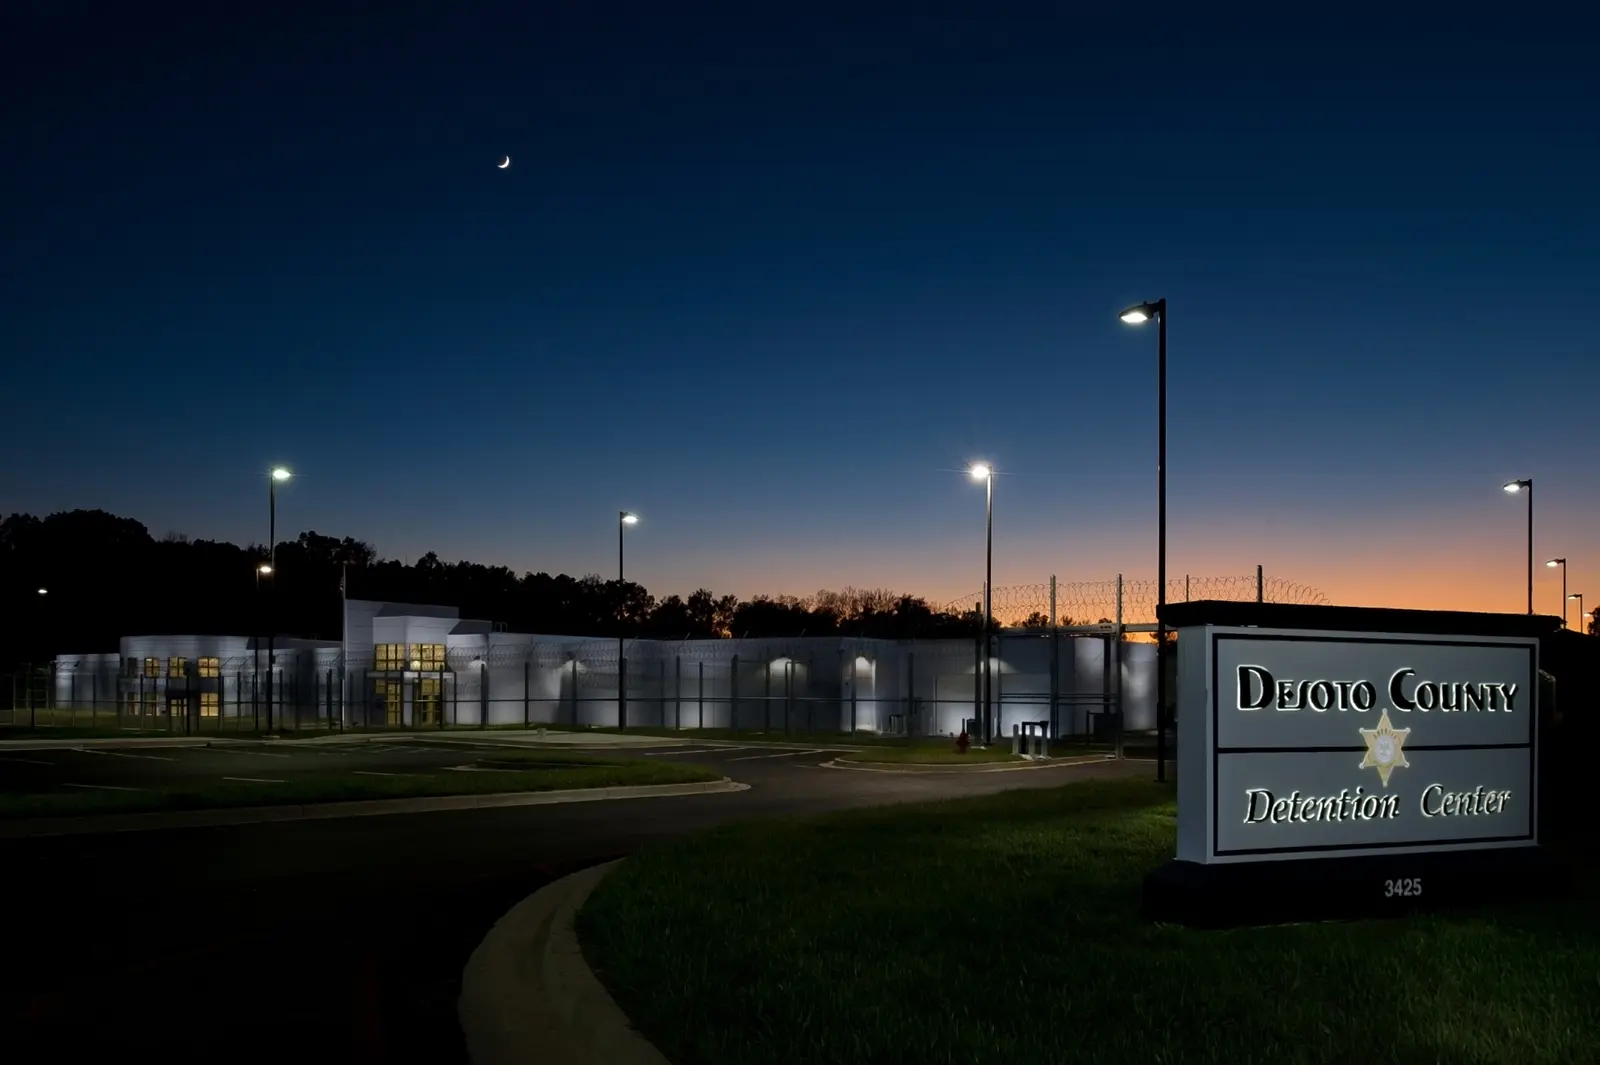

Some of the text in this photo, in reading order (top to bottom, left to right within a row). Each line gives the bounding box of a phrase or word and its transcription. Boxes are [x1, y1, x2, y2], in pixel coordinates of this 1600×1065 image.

[1388, 667, 1518, 712] COUNTY
[1243, 783, 1512, 824] Detention Center
[1384, 878, 1422, 897] 3425
